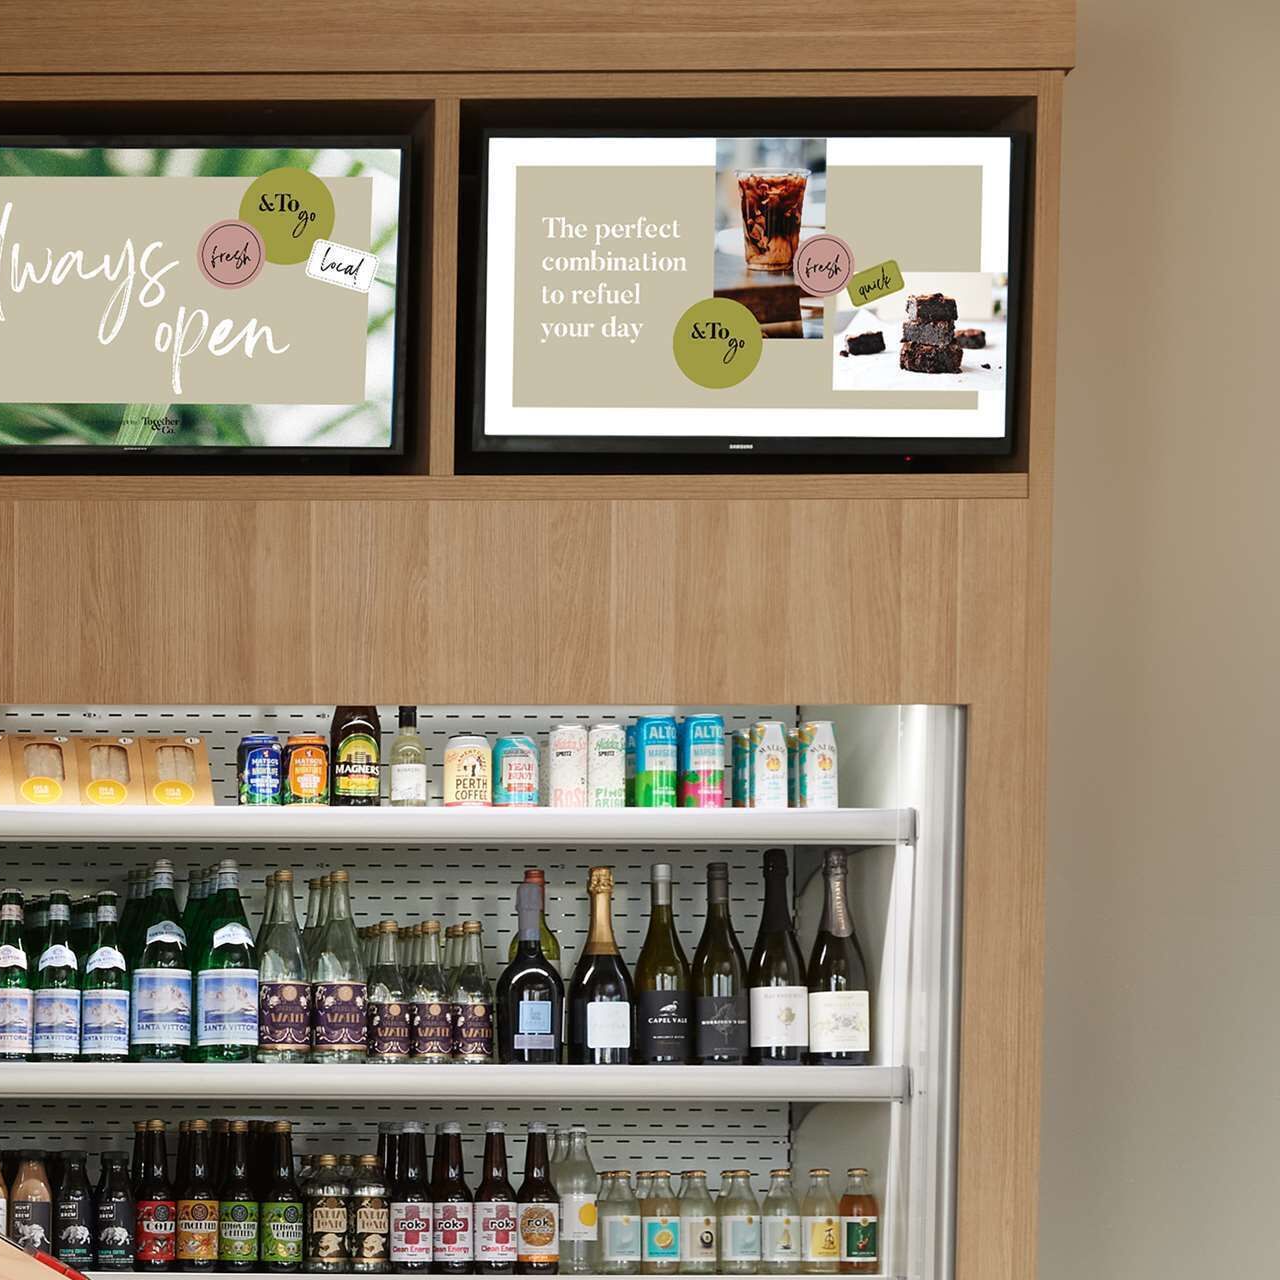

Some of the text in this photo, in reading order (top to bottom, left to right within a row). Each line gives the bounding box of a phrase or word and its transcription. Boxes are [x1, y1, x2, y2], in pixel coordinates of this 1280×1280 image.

[258, 193, 301, 215] &To
[297, 208, 317, 239] go
[542, 216, 680, 246] The perfect
[210, 242, 253, 269] fresh
[321, 246, 363, 285] local
[541, 250, 687, 273] combination
[804, 251, 842, 280] fresh
[541, 283, 641, 305] to refuel
[857, 267, 892, 301] quick
[540, 316, 644, 345] your day
[691, 321, 730, 340] &To
[154, 305, 291, 395] open
[726, 337, 746, 365] go
[335, 764, 379, 776] MAGNERS
[455, 789, 487, 800] COFFEE
[456, 778, 487, 789] PERTH
[137, 1023, 160, 1031] SANTA
[410, 1246, 430, 1254] Energ
